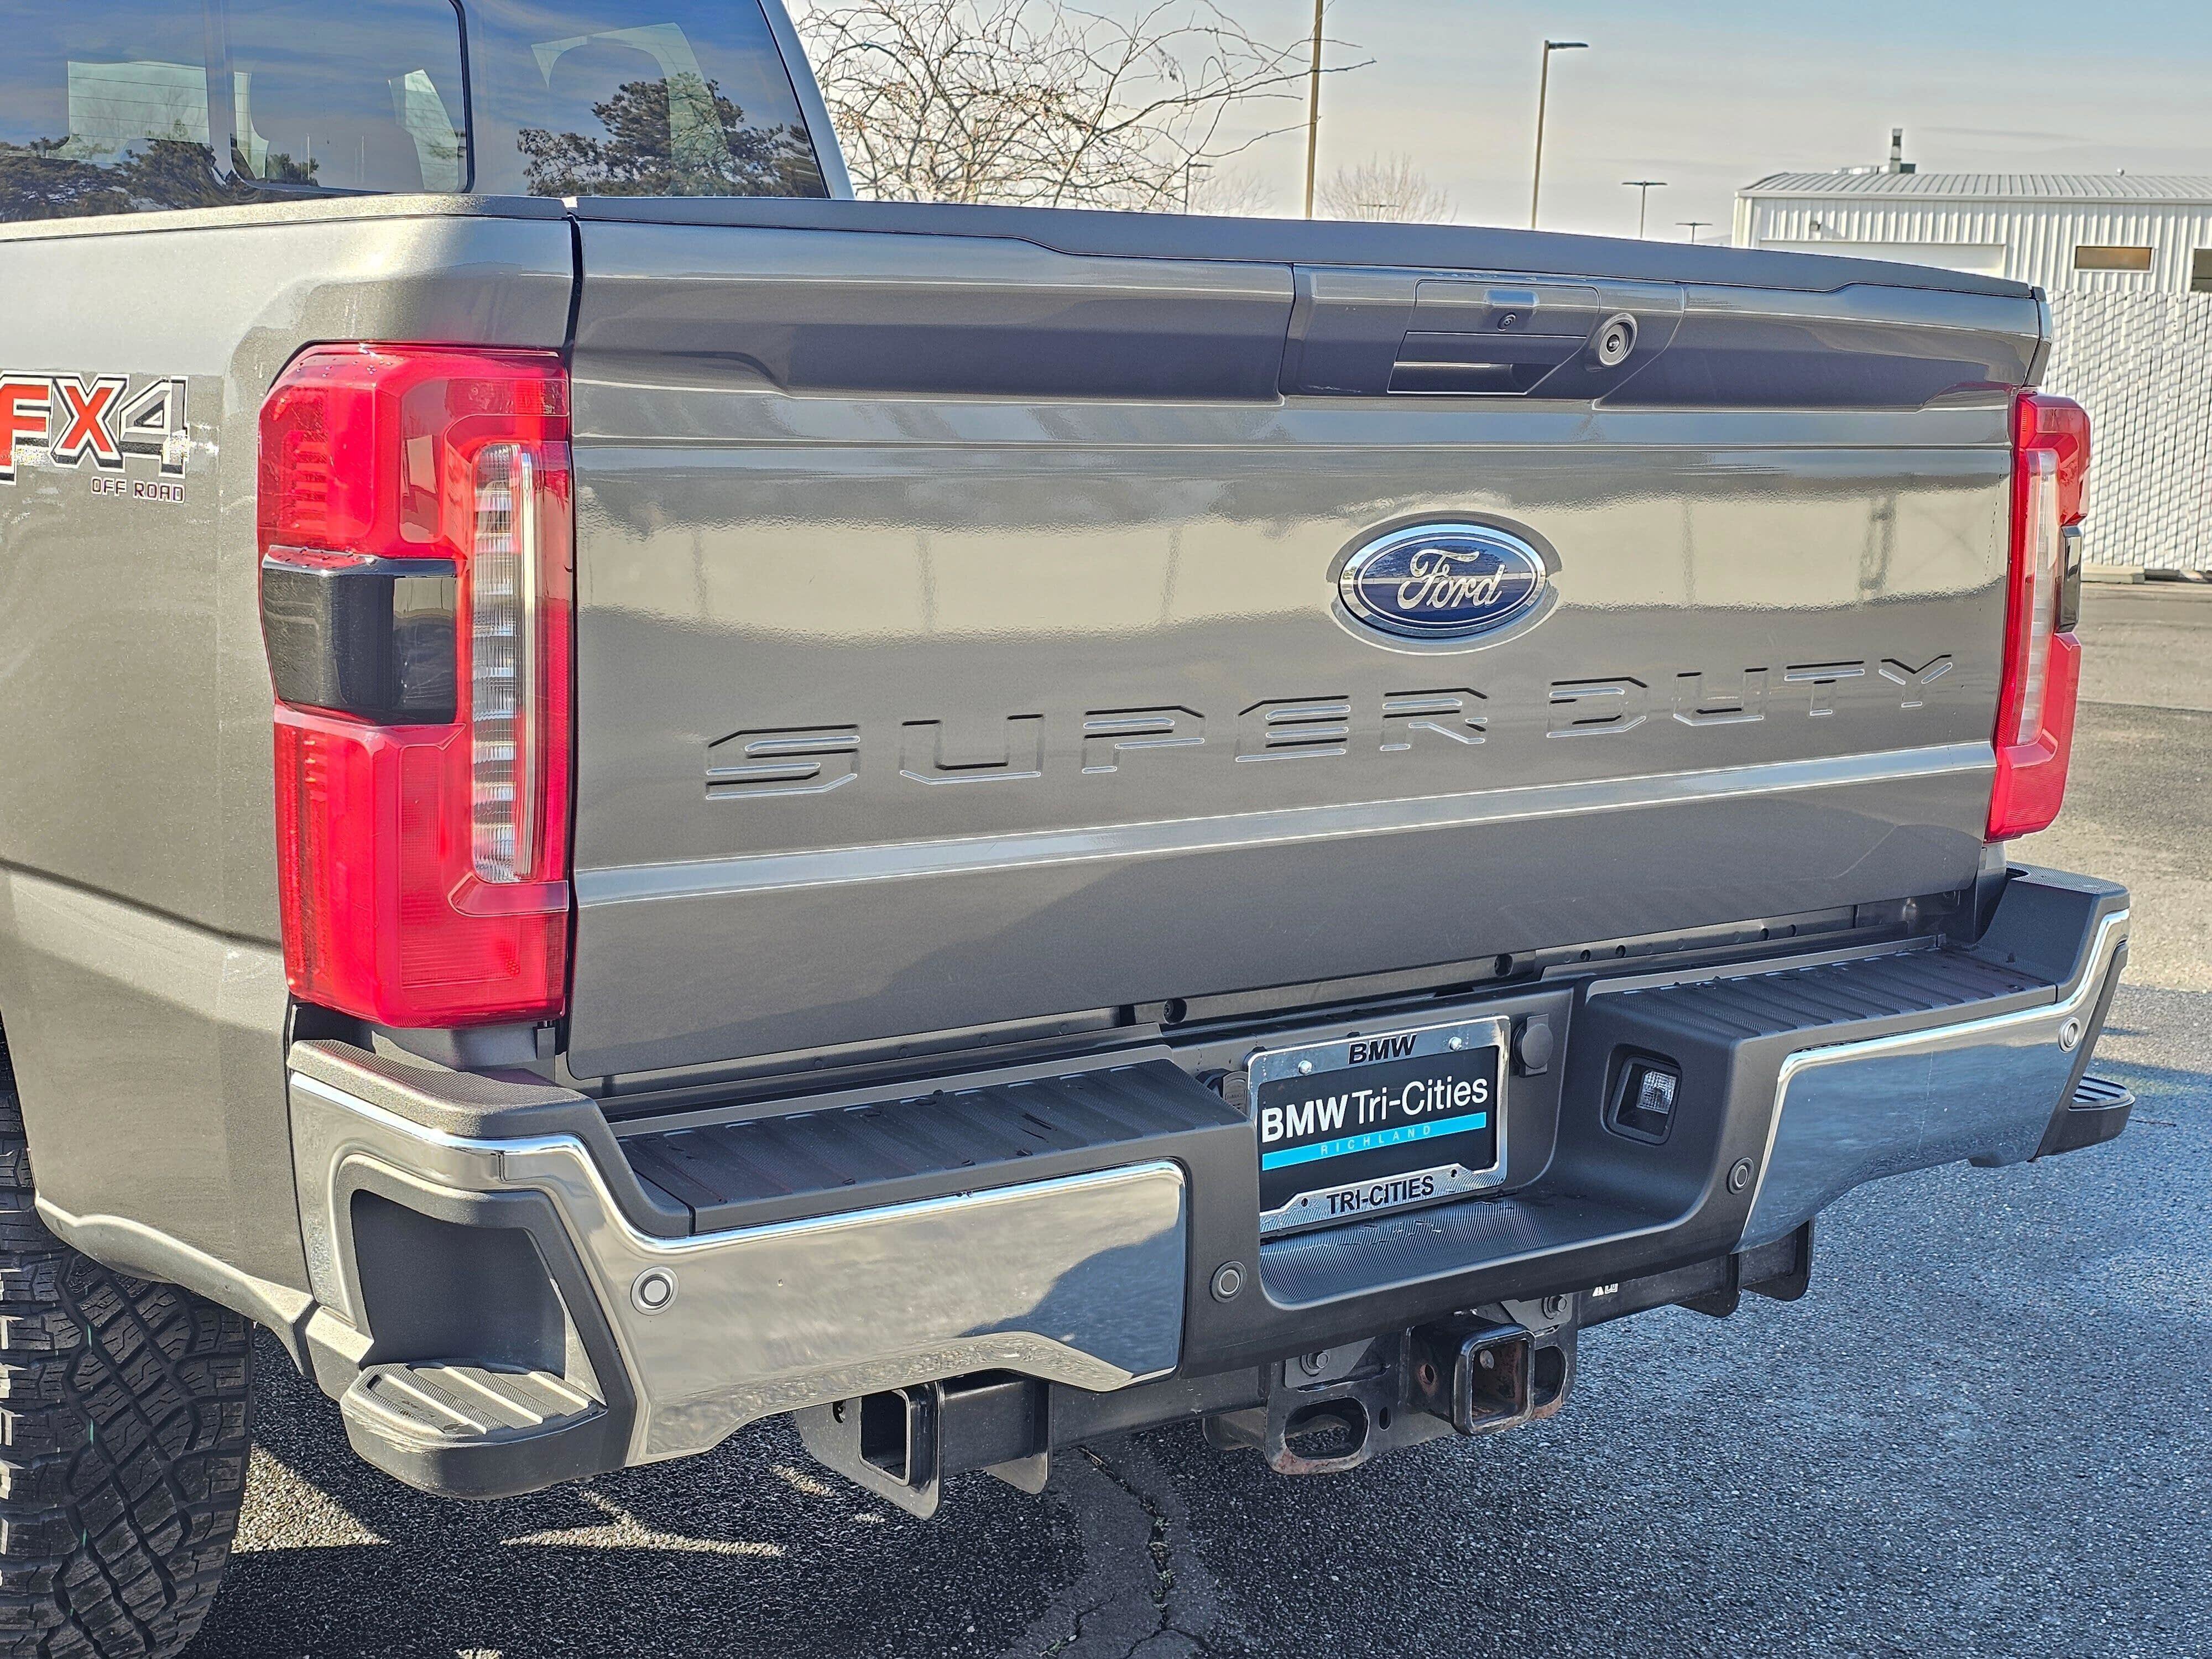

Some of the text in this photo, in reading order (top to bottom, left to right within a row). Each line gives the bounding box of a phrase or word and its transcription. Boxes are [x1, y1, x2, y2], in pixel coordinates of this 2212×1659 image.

[0, 369, 190, 486] FX4
[91, 477, 185, 504] OFF ROAD
[1396, 547, 1507, 610] Ford
[705, 653, 1954, 800] SUPER DUTY
[1348, 1034, 1417, 1066] BMW
[1261, 1076, 1489, 1143] BMW Tri-Cities
[1321, 1126, 1431, 1156] RICHLAND
[1326, 1175, 1434, 1215] TRI-CITIES
